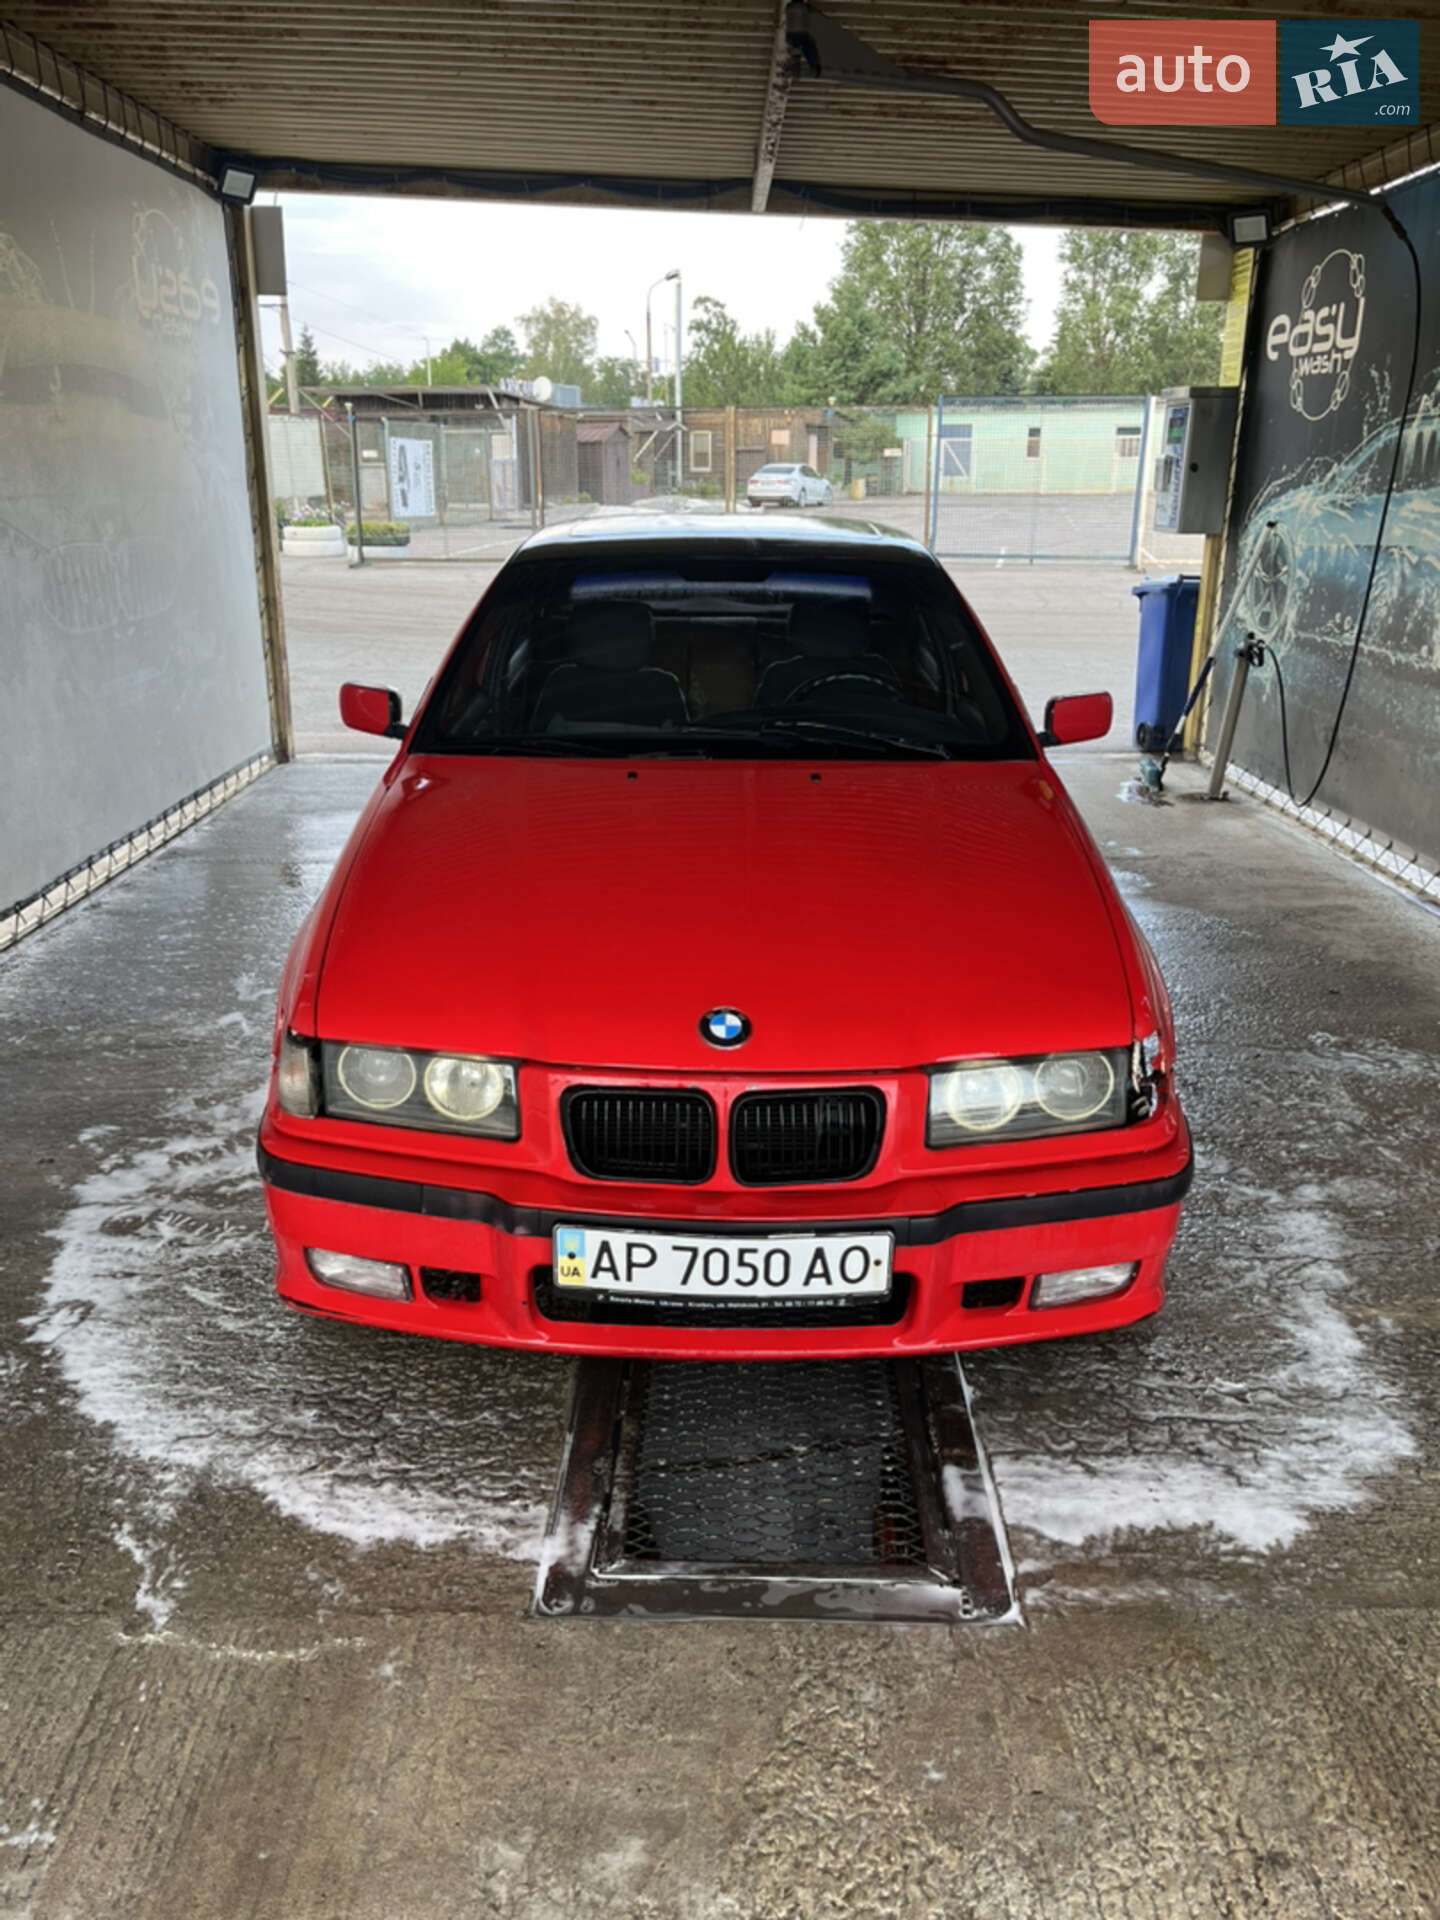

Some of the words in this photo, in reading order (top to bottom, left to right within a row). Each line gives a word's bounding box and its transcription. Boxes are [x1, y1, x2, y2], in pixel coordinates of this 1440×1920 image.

[1266, 296, 1365, 361] easy
[1299, 352, 1342, 375] wash
[560, 1265, 582, 1279] UA
[590, 1239, 658, 1283] AP
[671, 1245, 790, 1287] 7050
[802, 1244, 871, 1286] AO
